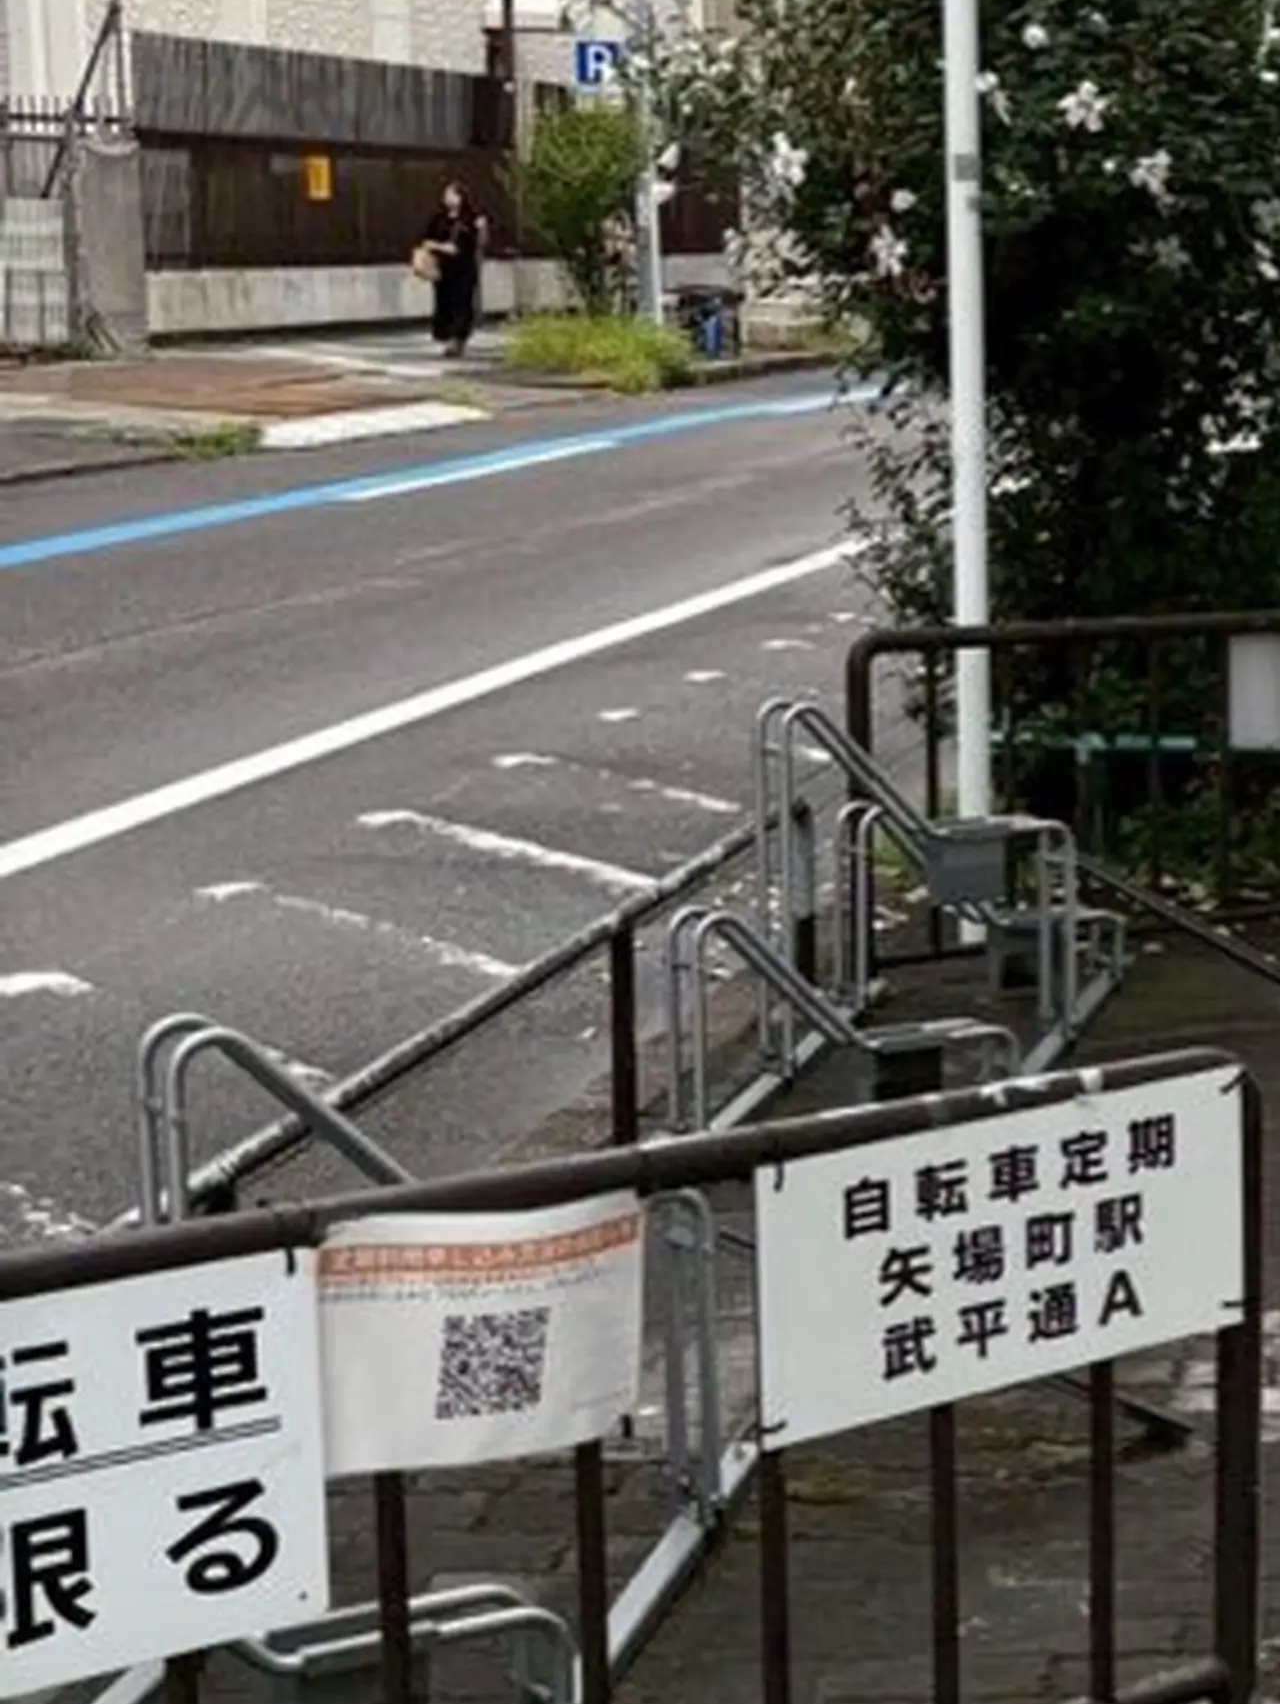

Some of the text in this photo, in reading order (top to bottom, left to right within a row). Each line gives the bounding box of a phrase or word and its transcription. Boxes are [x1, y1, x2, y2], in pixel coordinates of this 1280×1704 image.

[843, 1114, 1176, 1240] 自転車定期
[879, 1194, 1143, 1306] 矢場町駅
[883, 1271, 1143, 1380] 武平通A
